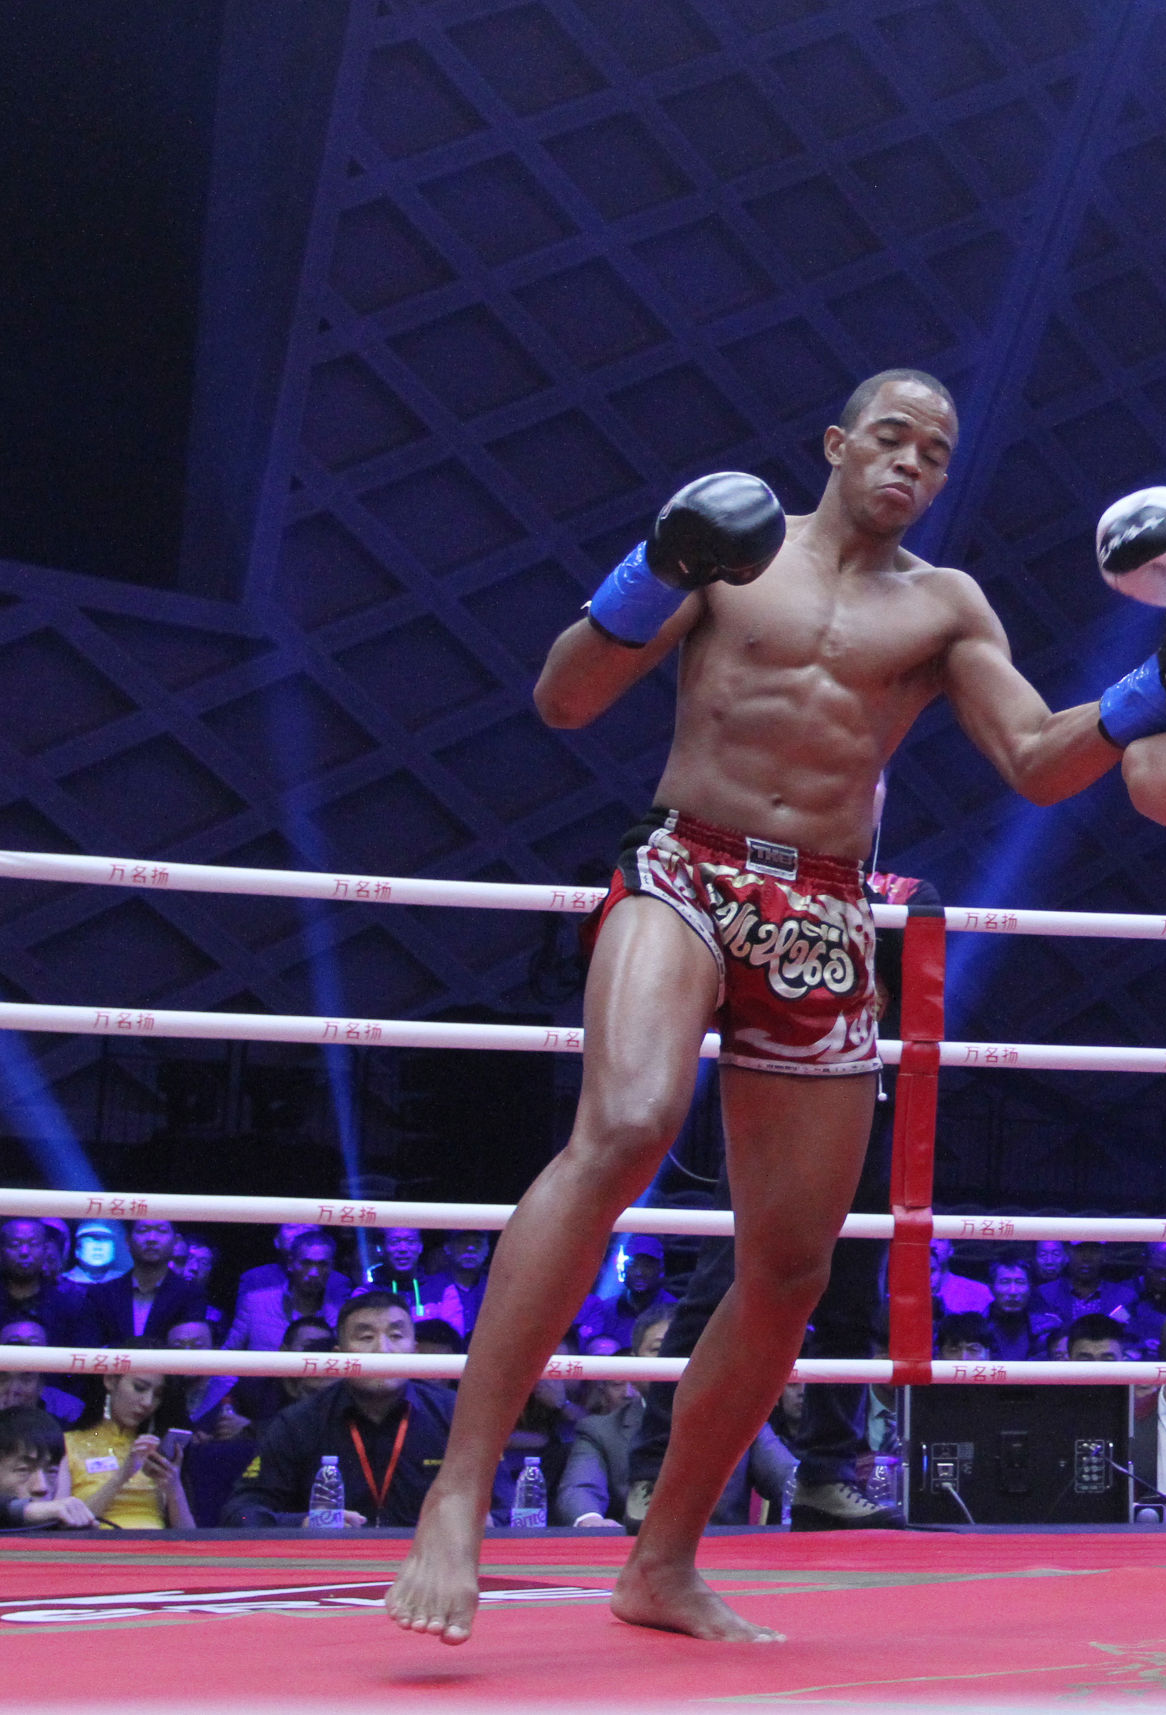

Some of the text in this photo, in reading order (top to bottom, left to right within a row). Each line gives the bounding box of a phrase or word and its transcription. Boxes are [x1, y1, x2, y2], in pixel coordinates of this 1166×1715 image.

[109, 864, 169, 884] 万名扬
[333, 879, 392, 899] 万名扬
[965, 912, 1017, 930] 万名扬
[93, 1011, 155, 1030] 万名扬
[322, 1021, 382, 1040] 万名扬
[965, 1046, 1018, 1064] 万名扬
[86, 1198, 147, 1216] 万名扬
[318, 1205, 376, 1225] 万名扬
[961, 1219, 1014, 1236] 万名扬
[70, 1354, 131, 1372] 万名扬
[302, 1358, 361, 1376] 万名扬
[952, 1365, 1007, 1382] 万名扬
